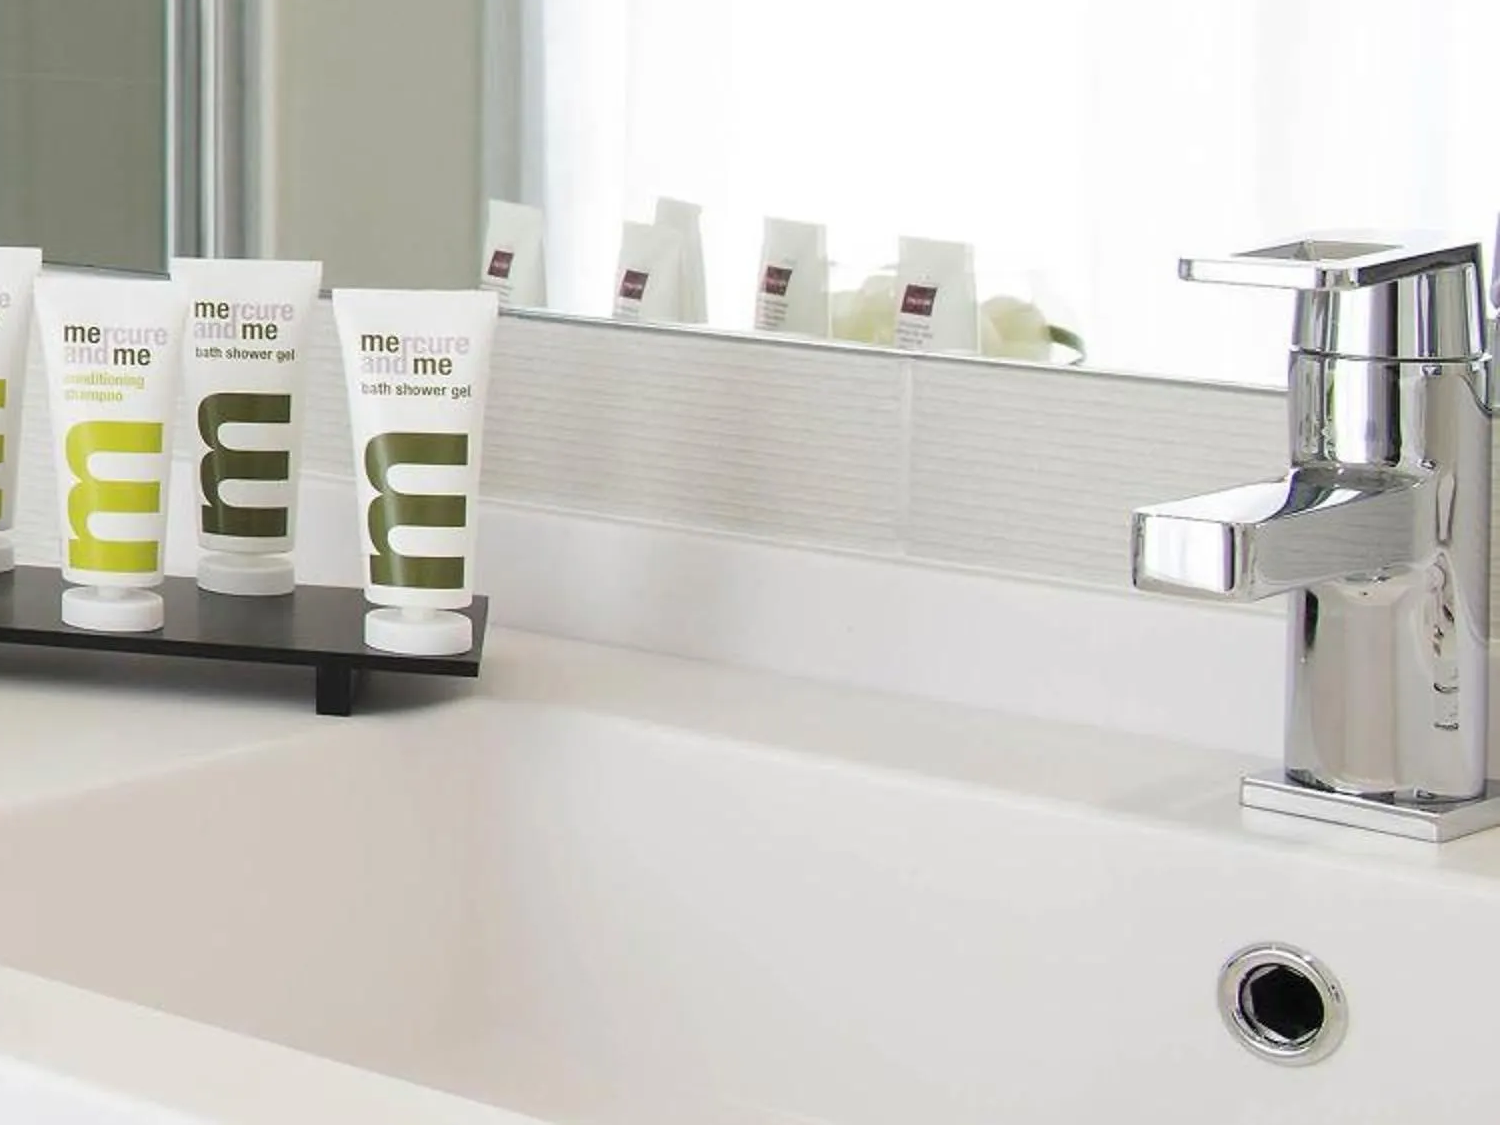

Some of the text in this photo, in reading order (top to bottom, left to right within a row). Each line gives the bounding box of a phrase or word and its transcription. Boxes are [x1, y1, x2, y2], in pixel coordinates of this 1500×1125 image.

[195, 301, 294, 321] mercure
[63, 325, 167, 345] mercure
[194, 316, 278, 340] and me
[65, 340, 151, 365] and me
[361, 334, 470, 354] mercure
[195, 346, 296, 363] bath shower gel
[361, 350, 453, 376] and me
[361, 381, 472, 400] bath shower gel
